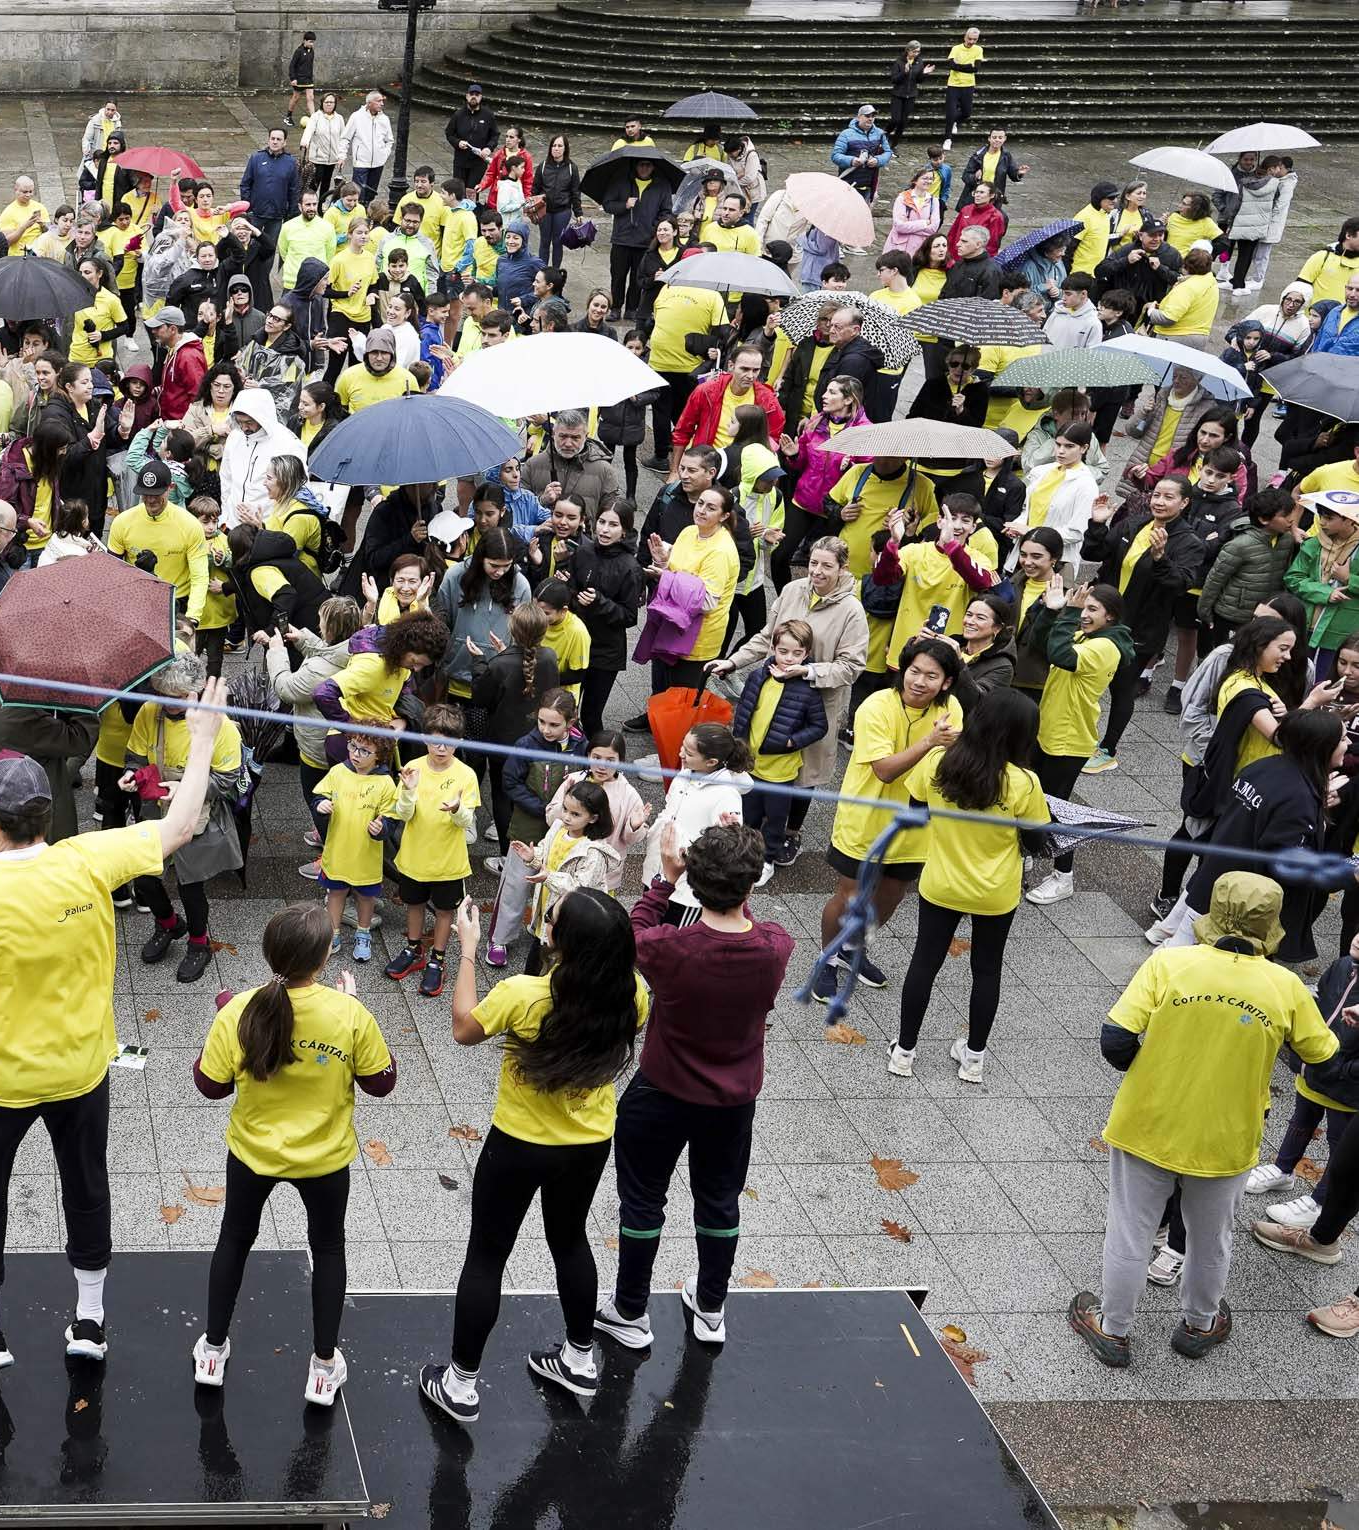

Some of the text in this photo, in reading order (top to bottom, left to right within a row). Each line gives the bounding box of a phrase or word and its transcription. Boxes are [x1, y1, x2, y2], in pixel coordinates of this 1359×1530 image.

[58, 903, 93, 923] galicia
[1172, 994, 1273, 1028] Corre X CÁRITAS
[299, 1039, 349, 1063] CÁRITAS
